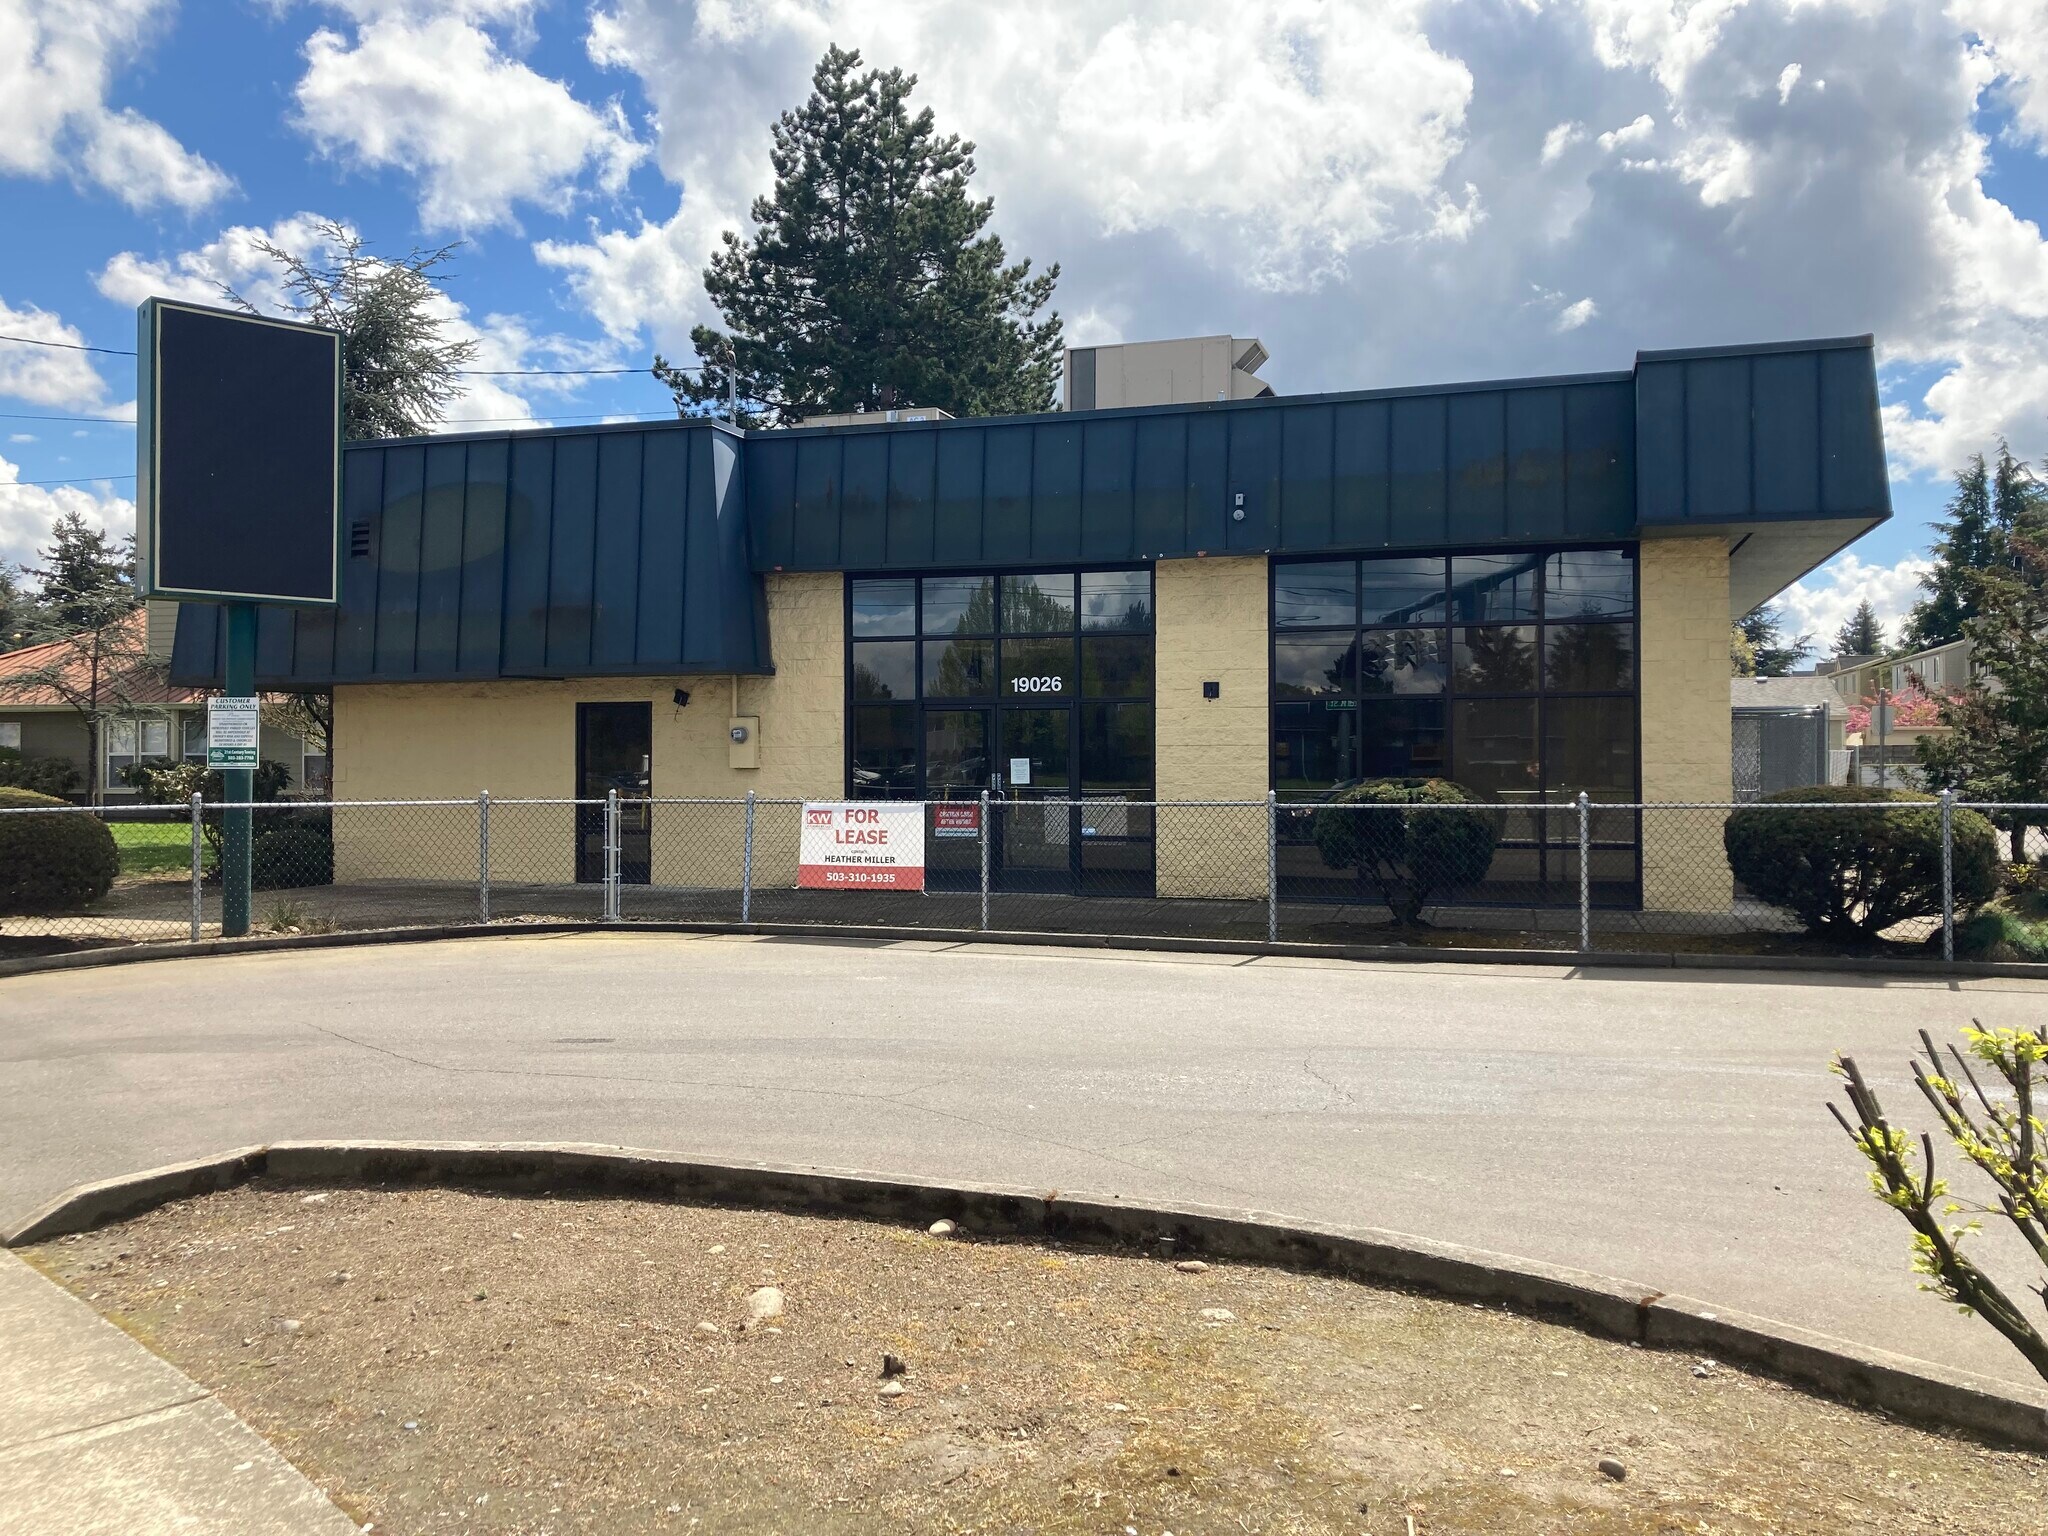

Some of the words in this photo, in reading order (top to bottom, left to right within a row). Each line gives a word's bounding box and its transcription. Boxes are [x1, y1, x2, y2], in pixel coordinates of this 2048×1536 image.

[1011, 676, 1062, 692] 19026
[807, 812, 832, 823] KW
[844, 809, 880, 824] FOR
[835, 830, 888, 845] LEASE
[824, 855, 862, 863] HEATHER
[864, 856, 896, 864] MILLER
[826, 872, 896, 883] 503-310-1935
